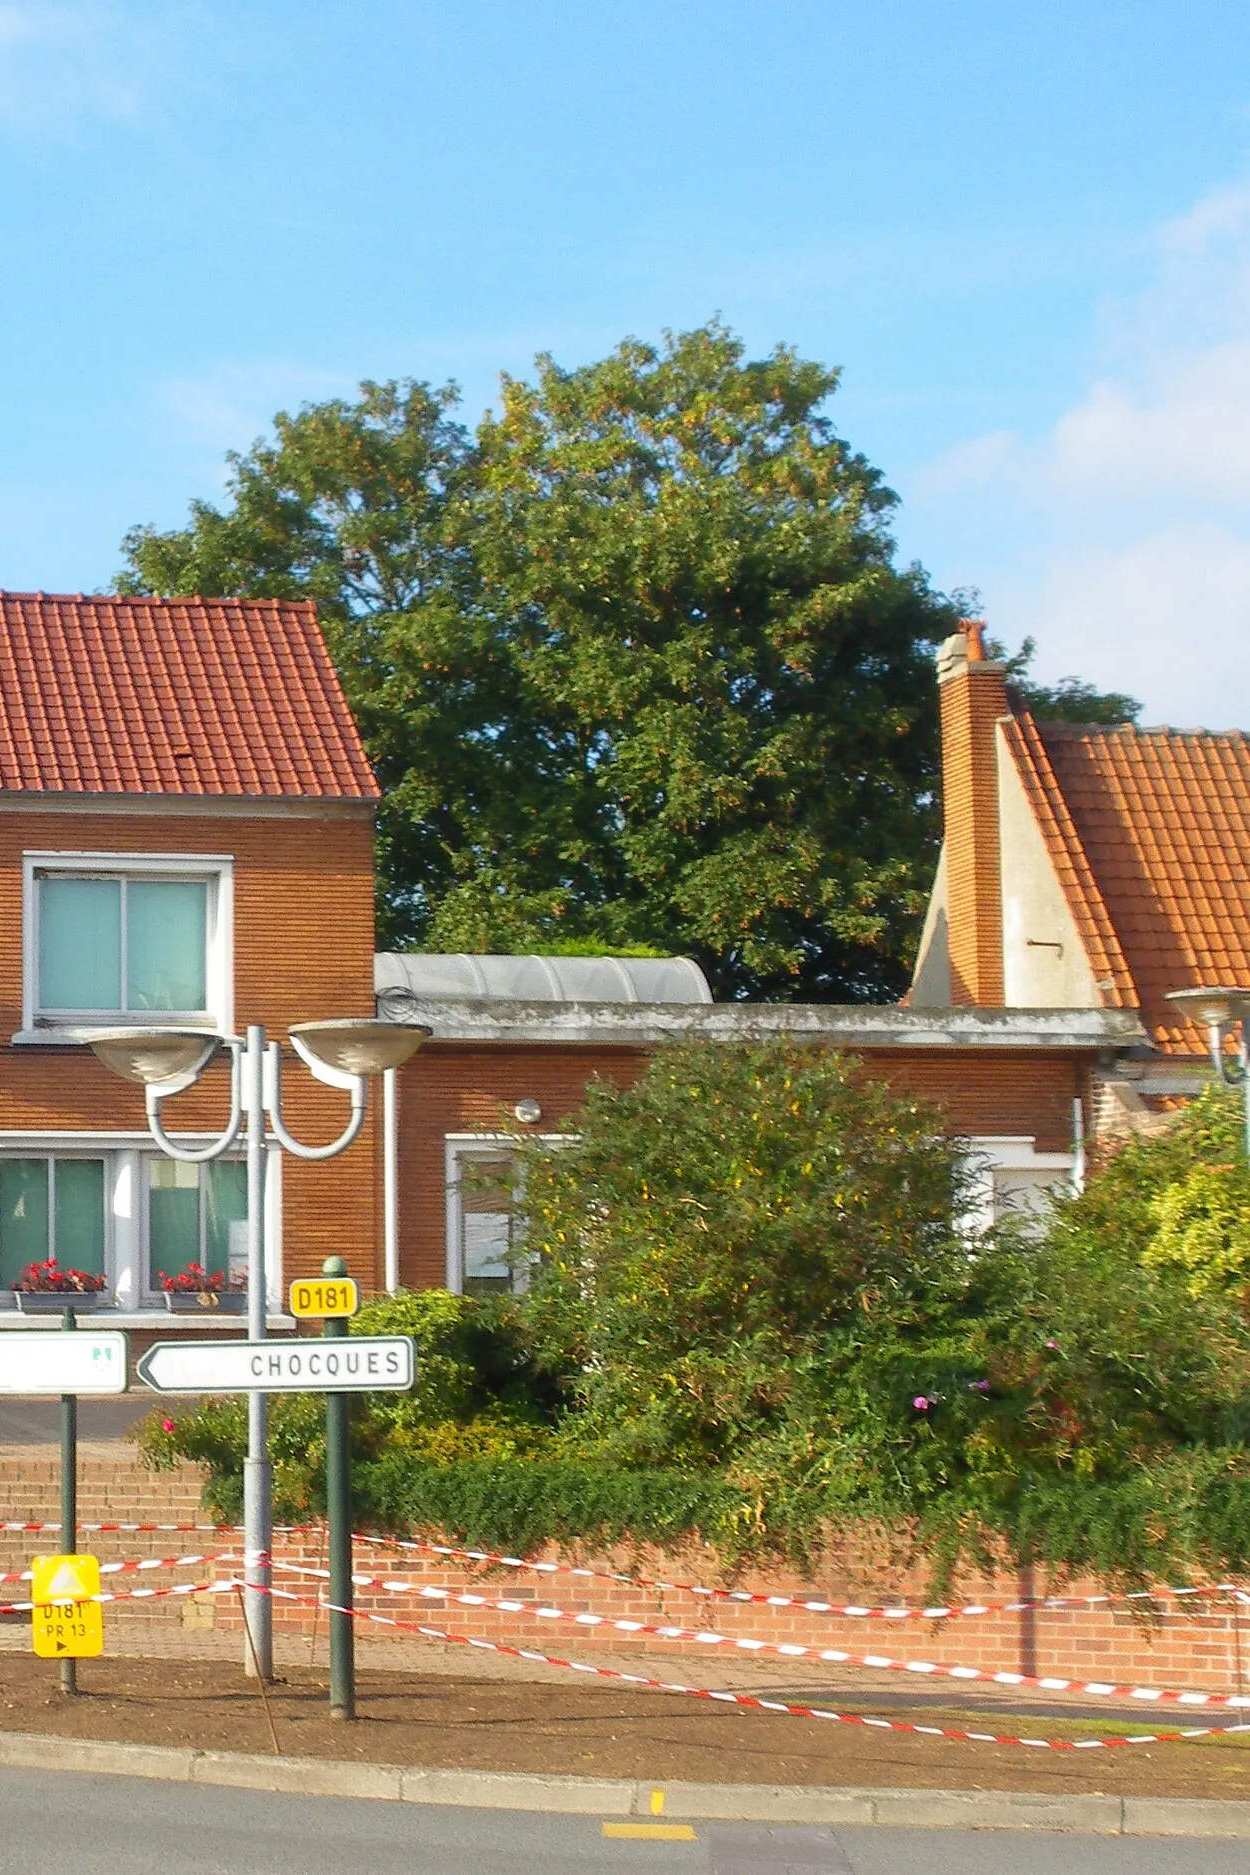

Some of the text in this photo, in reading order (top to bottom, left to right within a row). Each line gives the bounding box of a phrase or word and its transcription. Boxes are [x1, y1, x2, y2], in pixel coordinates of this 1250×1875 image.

[298, 1286, 349, 1310] D181
[251, 1352, 399, 1376] CHOCQUES
[46, 1623, 86, 1638] PR 13
